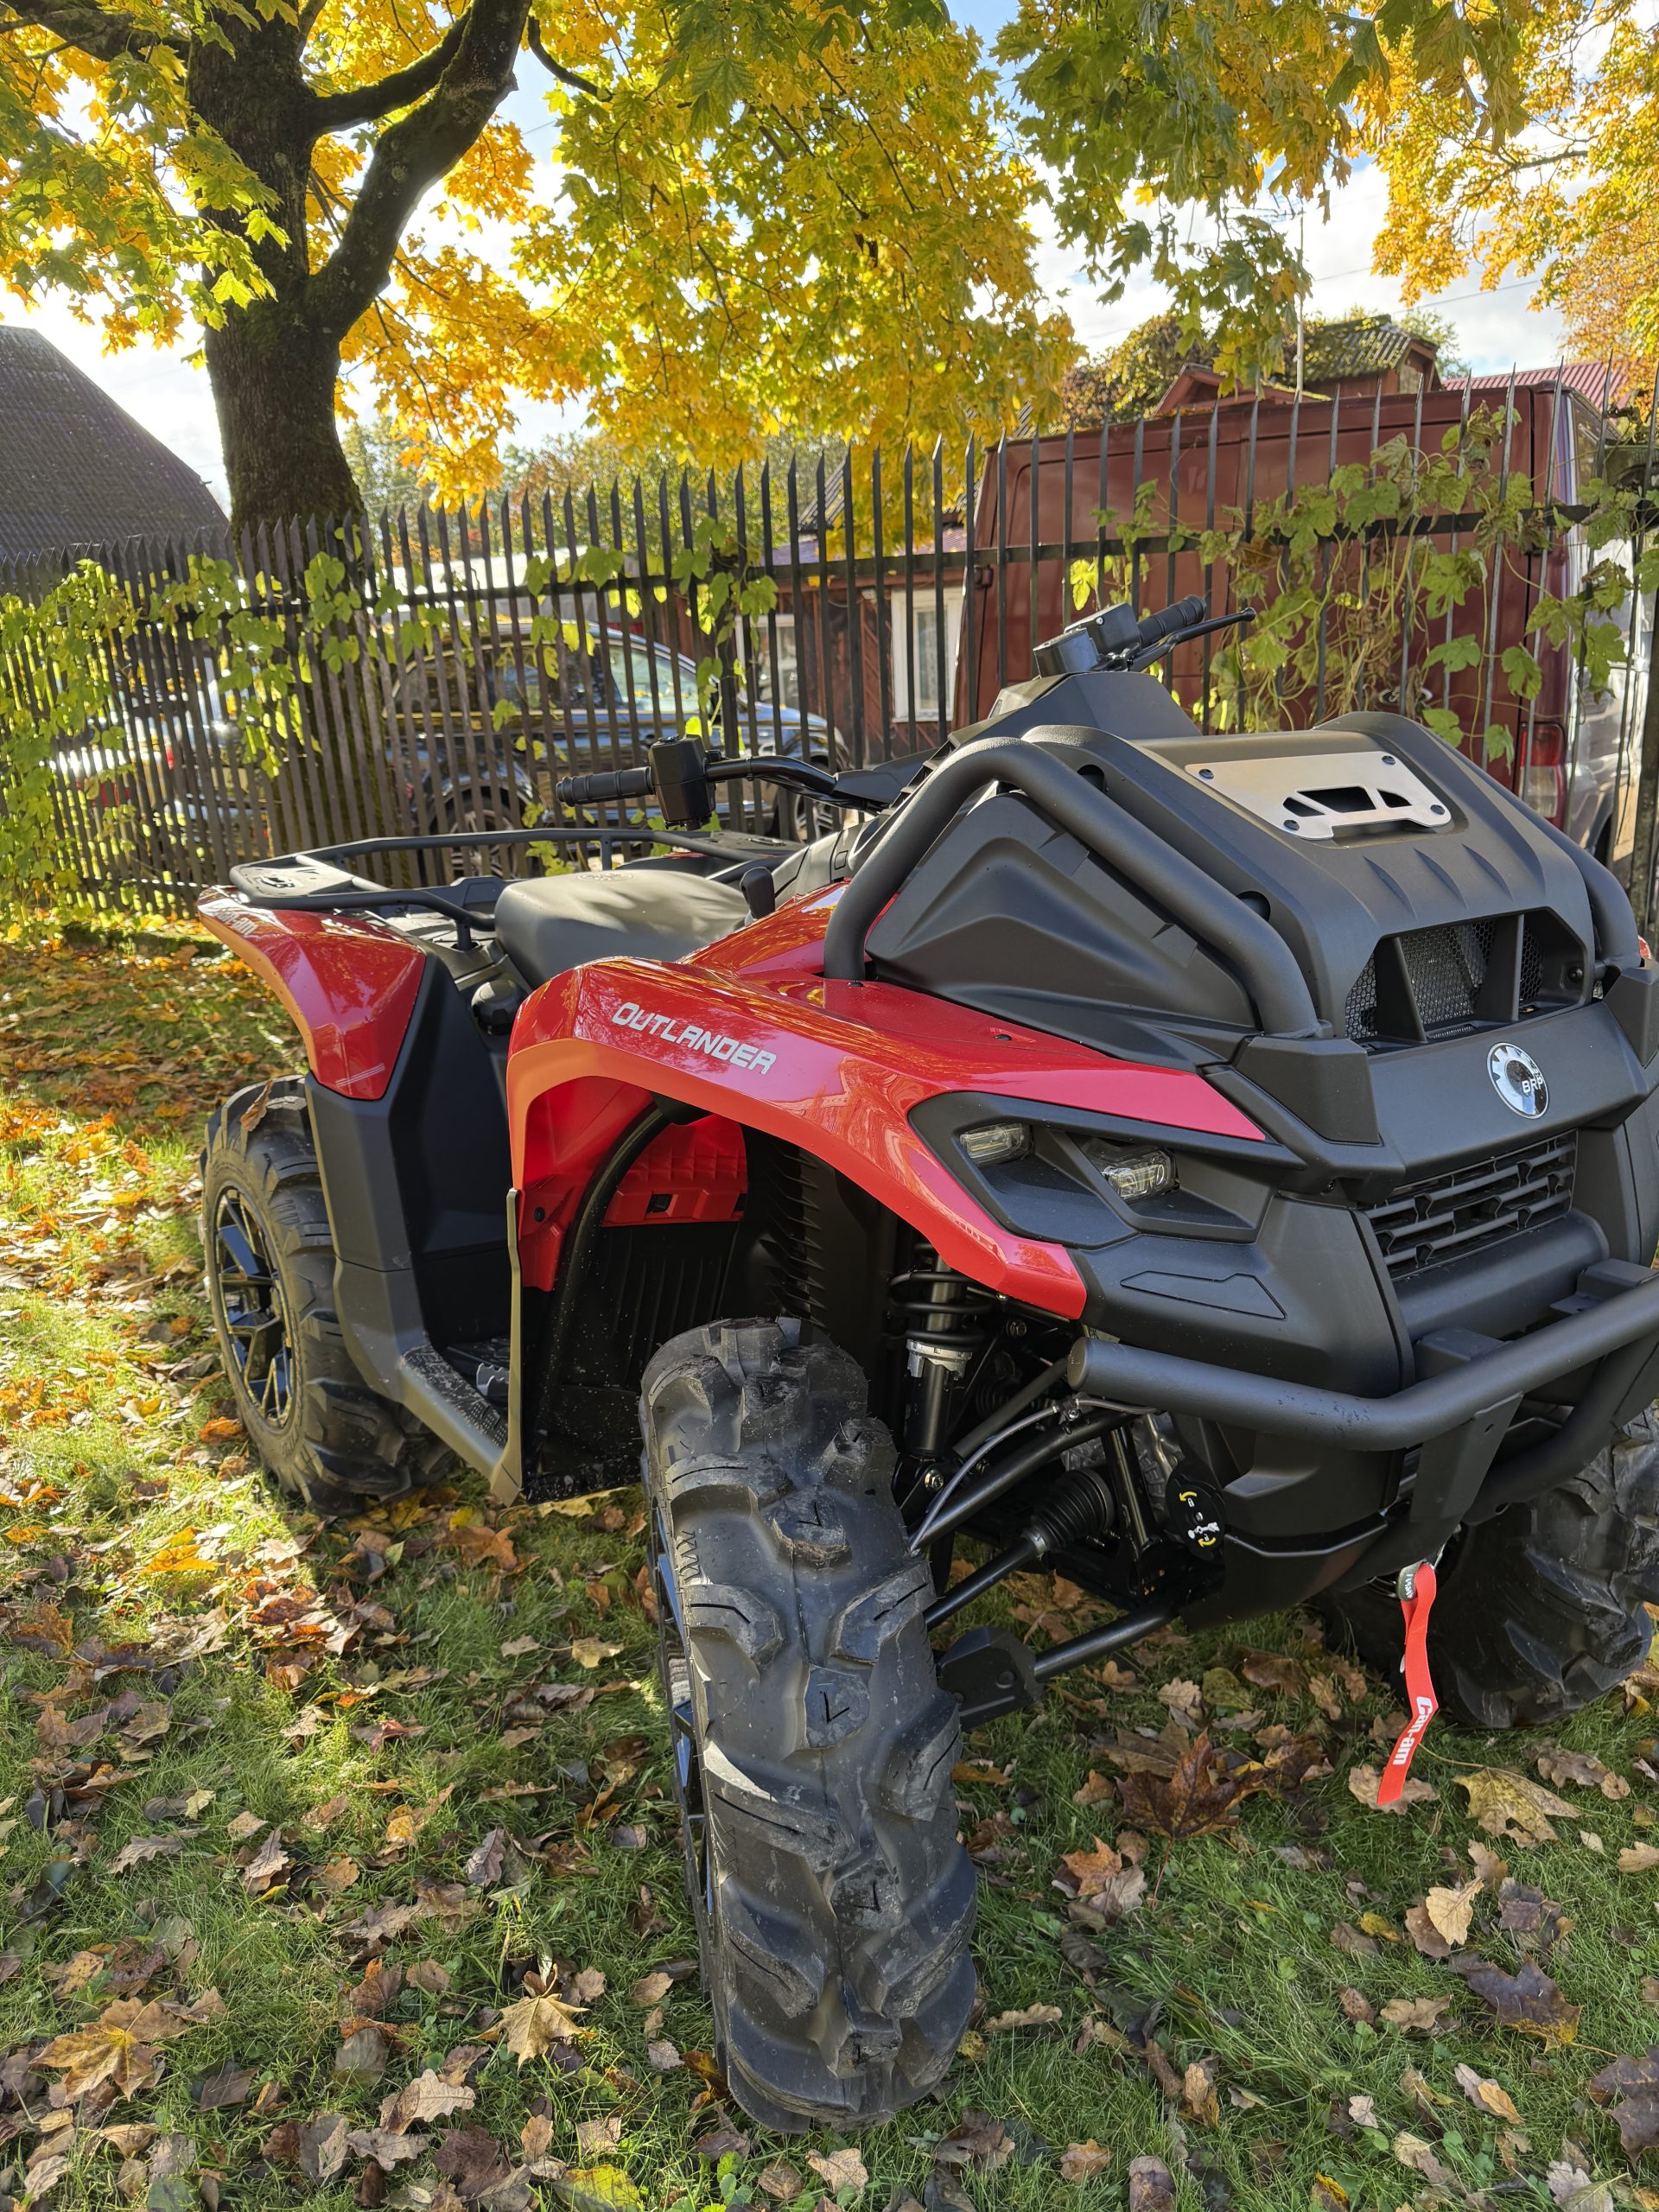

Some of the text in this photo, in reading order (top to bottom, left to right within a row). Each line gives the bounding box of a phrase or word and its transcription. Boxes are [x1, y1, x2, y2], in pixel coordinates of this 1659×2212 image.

[612, 1002, 777, 1075] OUTLANDER
[1522, 1077, 1543, 1093] BRP
[1392, 1696, 1433, 1765] Can-am
